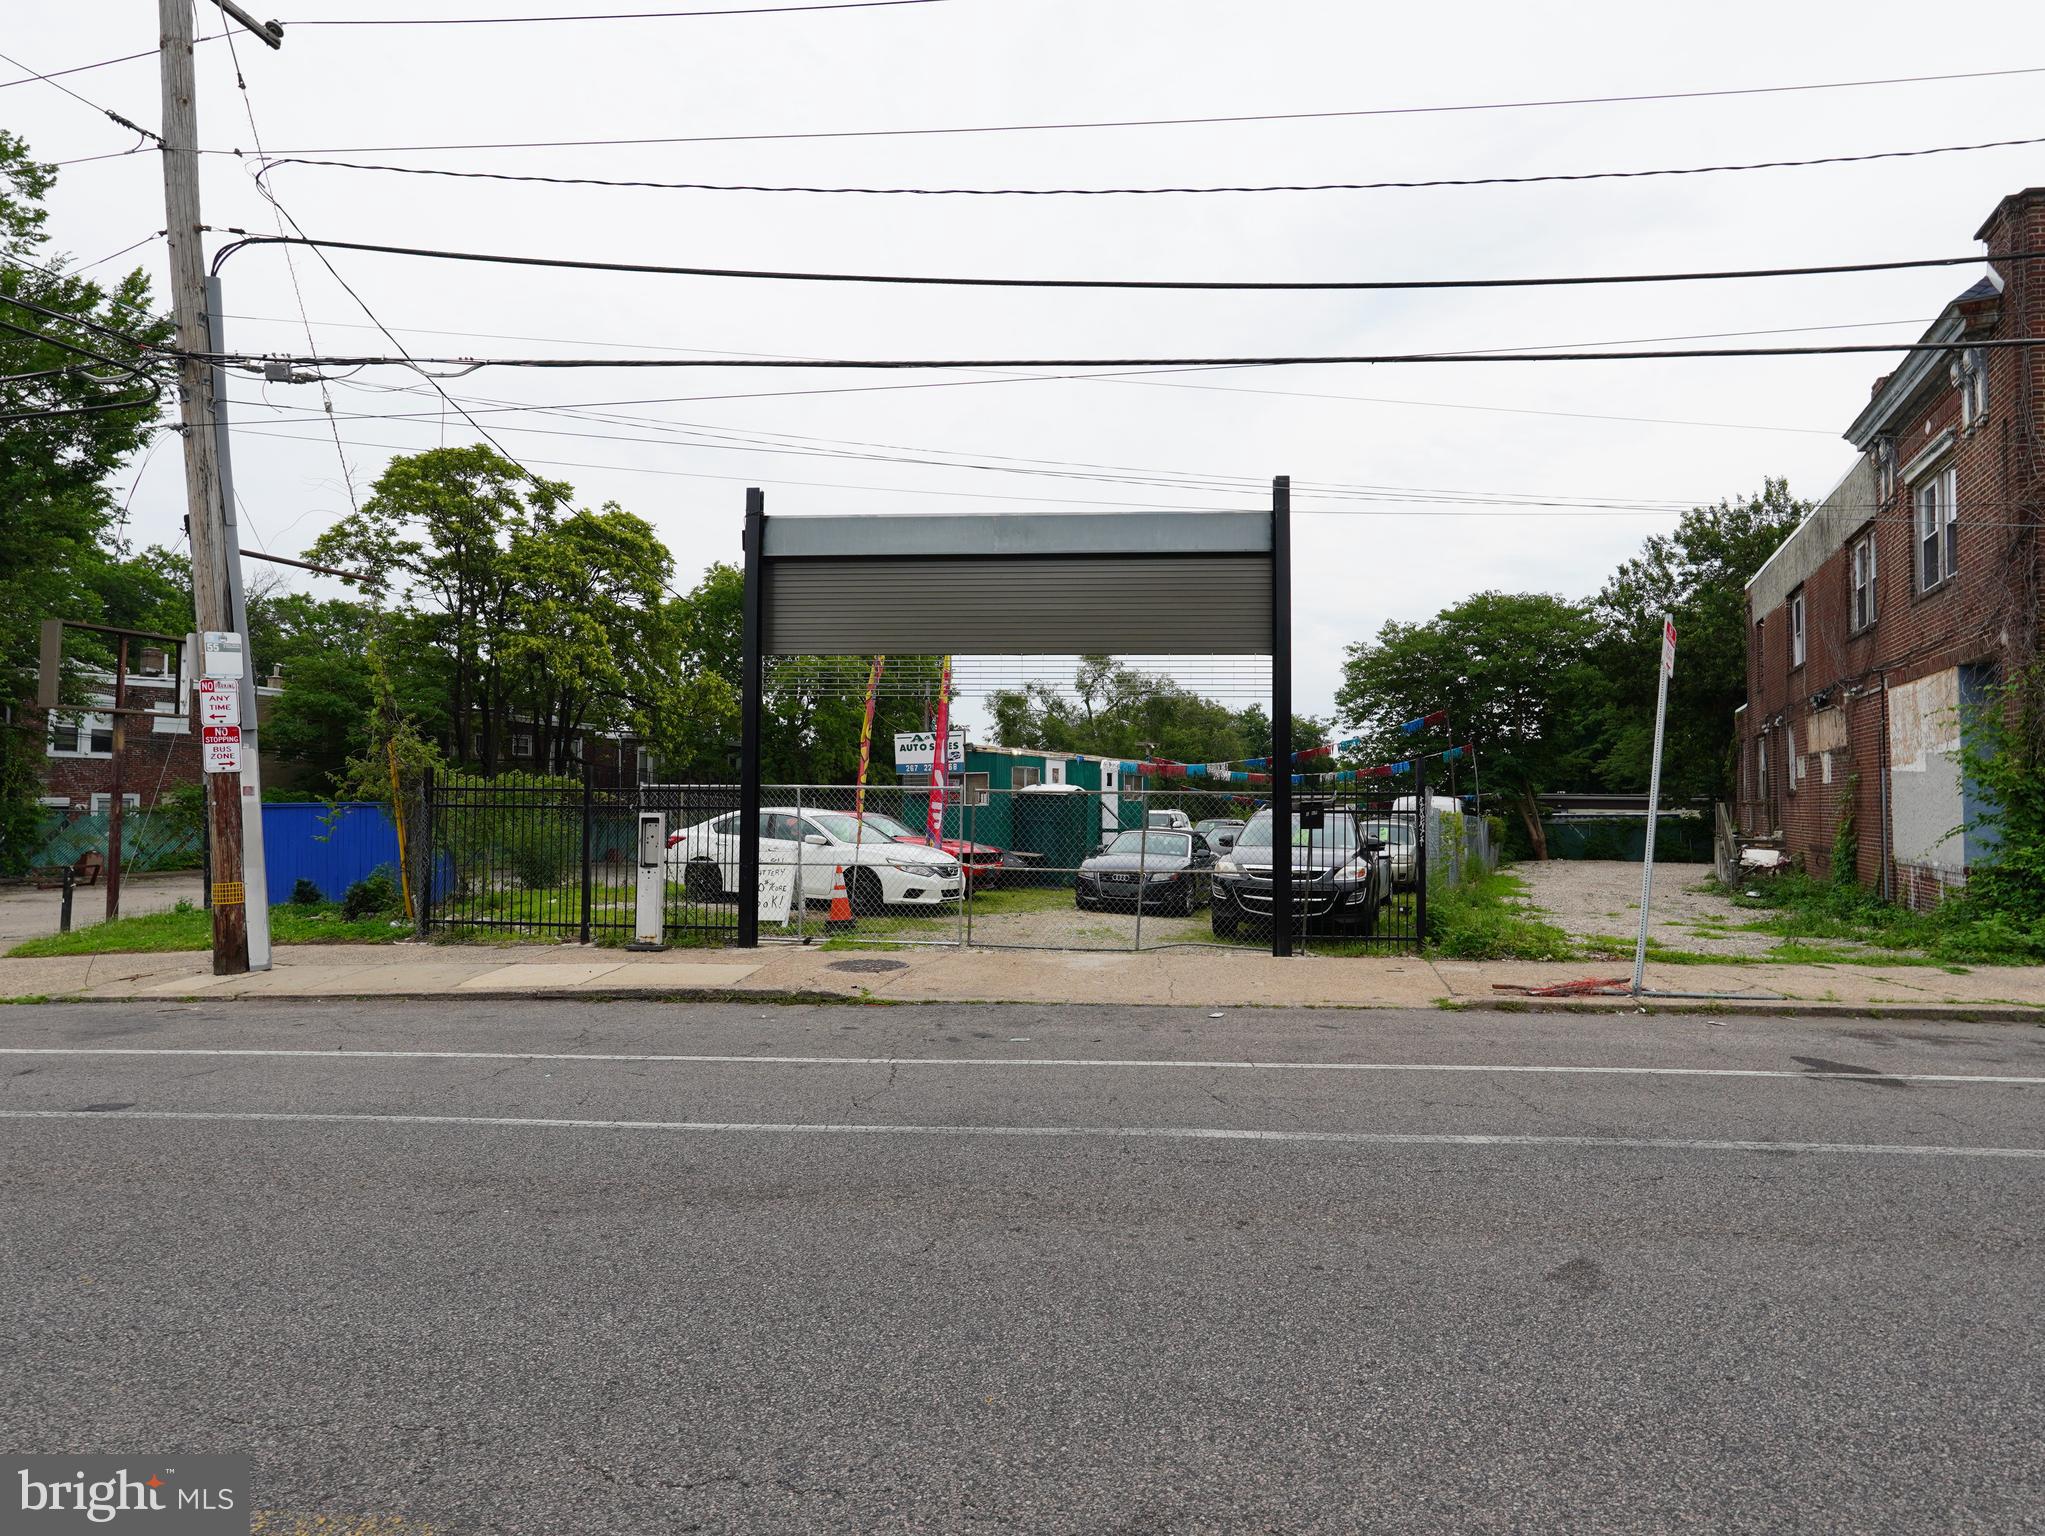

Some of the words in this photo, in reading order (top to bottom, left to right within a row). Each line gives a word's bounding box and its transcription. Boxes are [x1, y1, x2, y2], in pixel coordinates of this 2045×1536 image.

[201, 682, 214, 691] NO
[214, 728, 228, 736] NO
[900, 743, 927, 752] AUTO
[930, 742, 959, 751] SES
